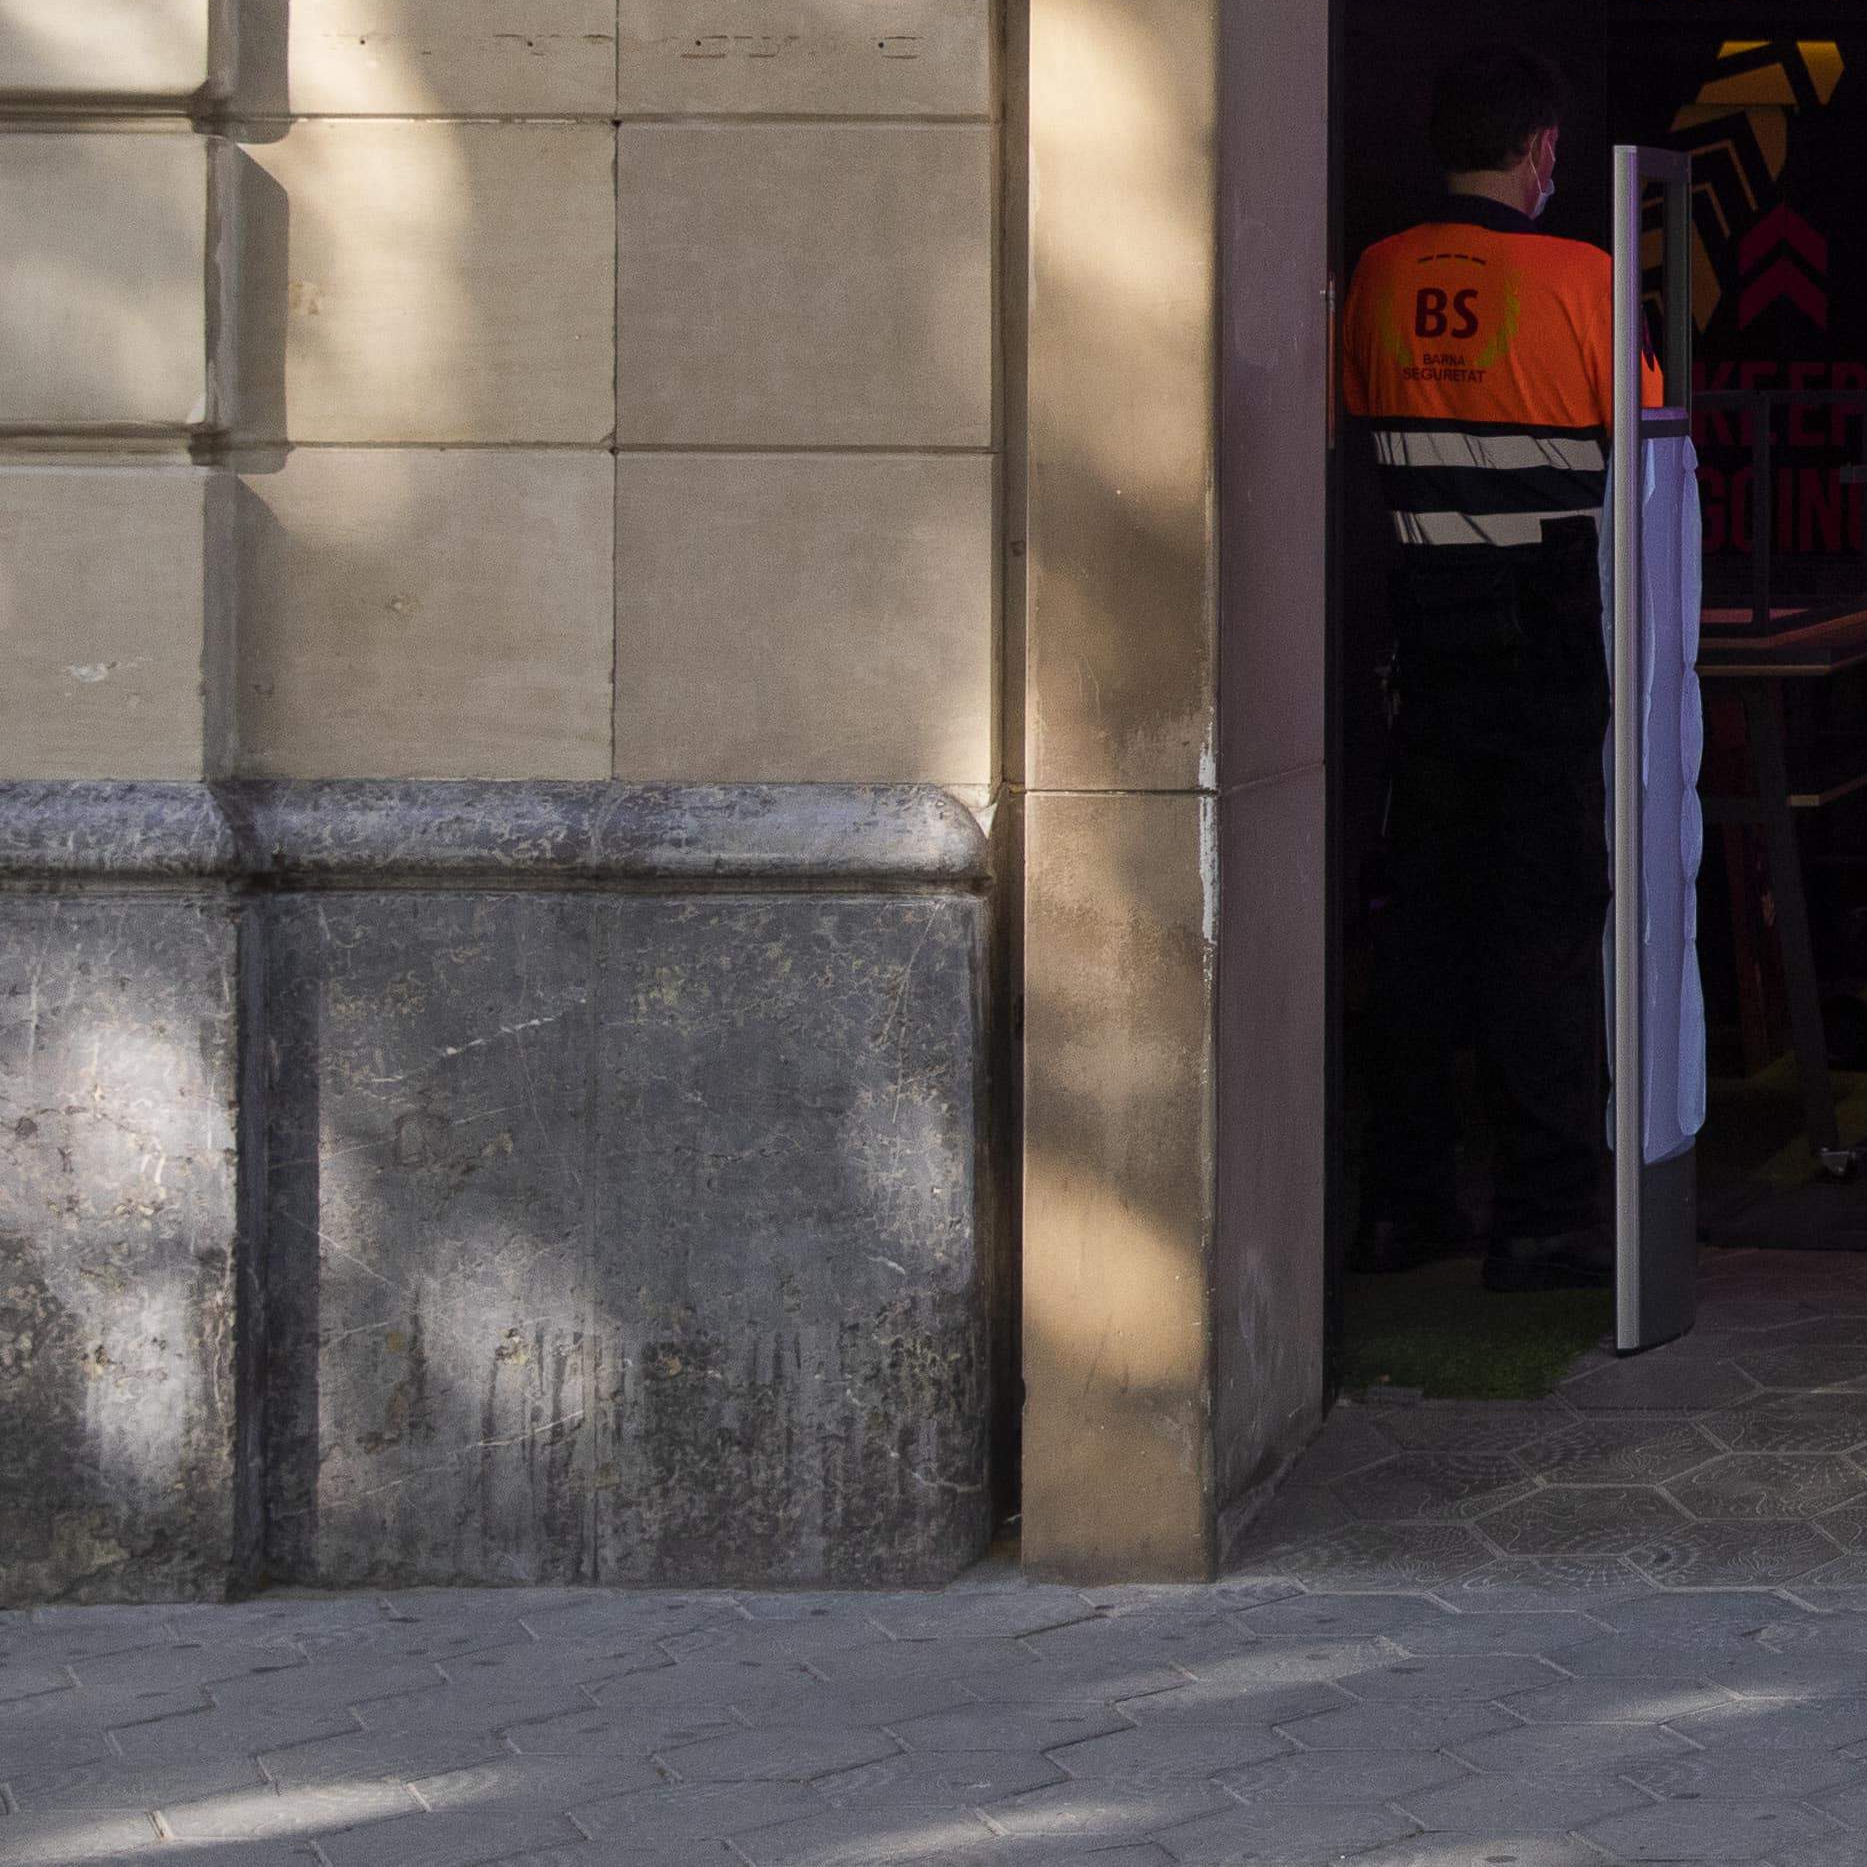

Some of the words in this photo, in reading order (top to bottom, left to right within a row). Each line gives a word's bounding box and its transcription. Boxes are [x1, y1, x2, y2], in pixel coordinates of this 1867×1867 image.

[1416, 288, 1480, 339] BS
[1424, 353, 1466, 366] BARNA
[1403, 368, 1487, 383] SEGURETAT
